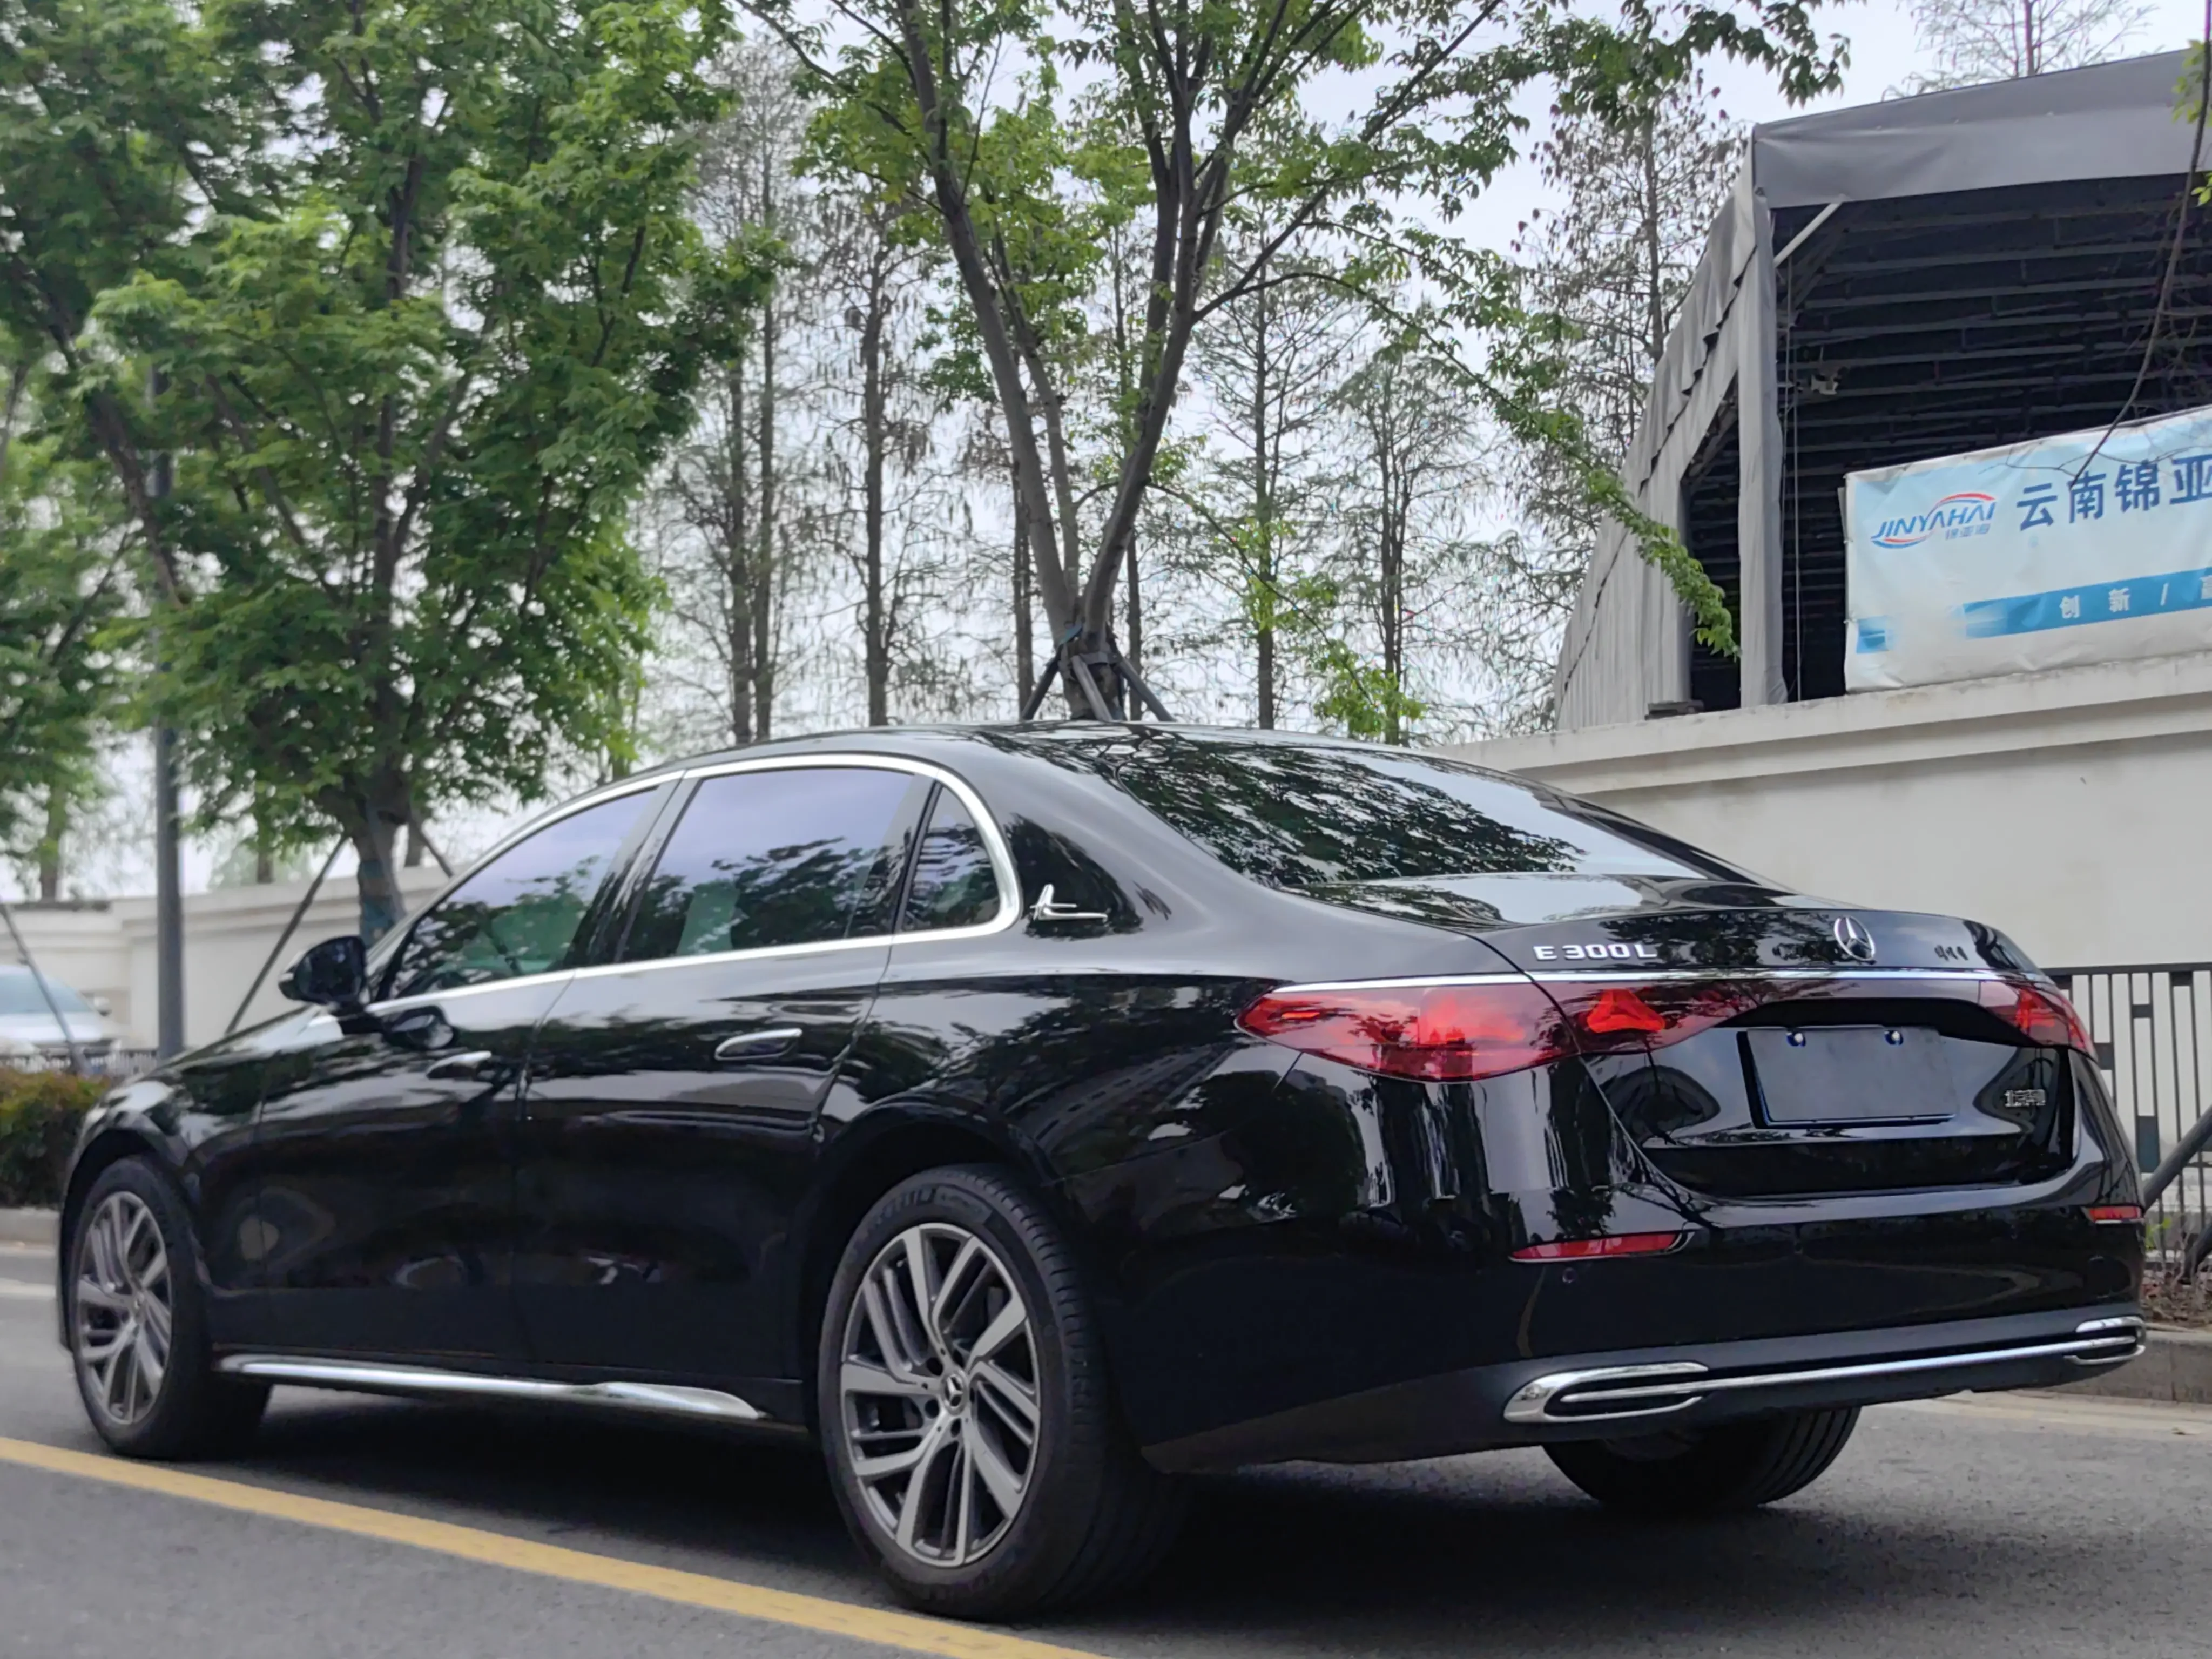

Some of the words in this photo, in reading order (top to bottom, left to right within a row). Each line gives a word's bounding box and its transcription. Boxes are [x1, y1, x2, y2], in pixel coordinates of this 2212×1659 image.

[1870, 502, 1997, 539] JINYAHAI
[2017, 454, 2212, 531] 云南锦亚
